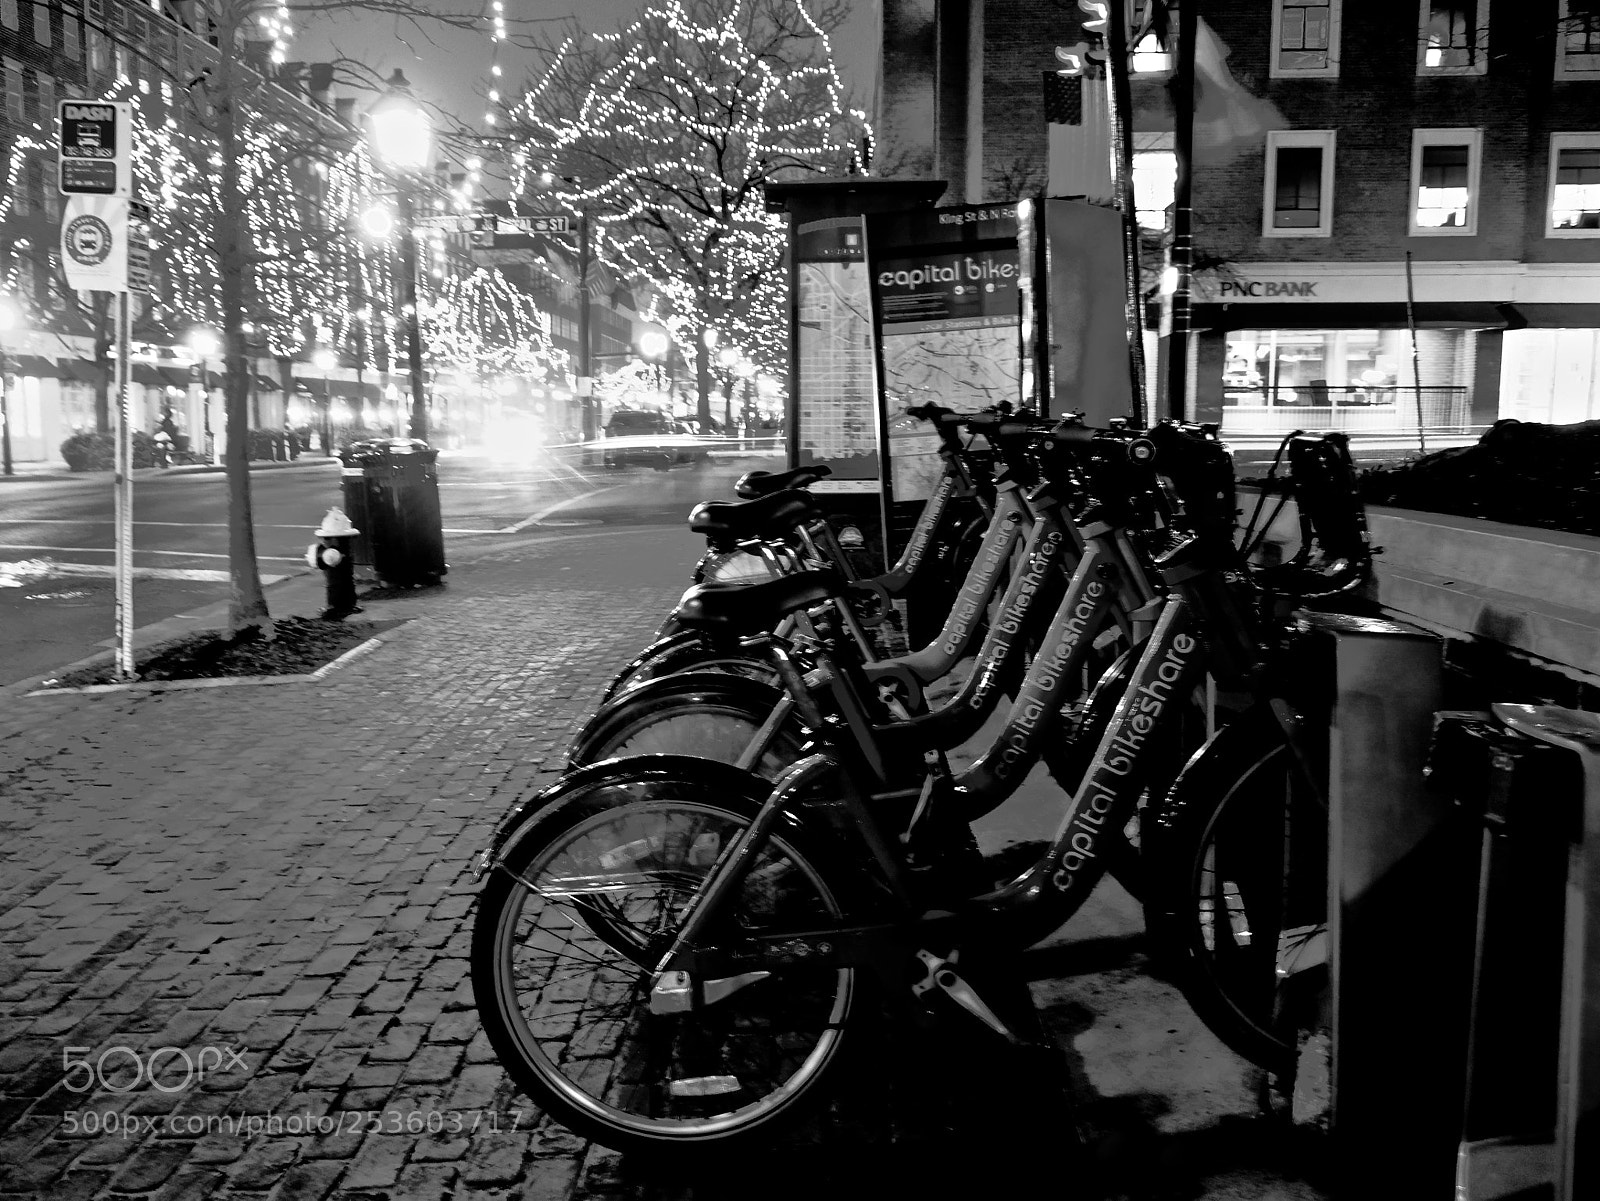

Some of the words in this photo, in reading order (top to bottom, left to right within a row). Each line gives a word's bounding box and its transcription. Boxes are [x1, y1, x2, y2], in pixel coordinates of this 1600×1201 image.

[65, 105, 113, 121] DASH
[549, 218, 564, 231] ST
[939, 213, 964, 225] King
[965, 211, 977, 221] St
[978, 210, 989, 220] &
[990, 209, 1000, 219] N
[1001, 208, 1016, 218] Ro
[878, 260, 959, 290] capital
[943, 597, 979, 655] capital
[969, 637, 1011, 709] capital
[994, 541, 1055, 635] bikeshare
[995, 694, 1046, 779] capital
[1028, 581, 1103, 692] bikeshare
[1053, 780, 1118, 891] capital
[1101, 633, 1195, 776] bikeshare
